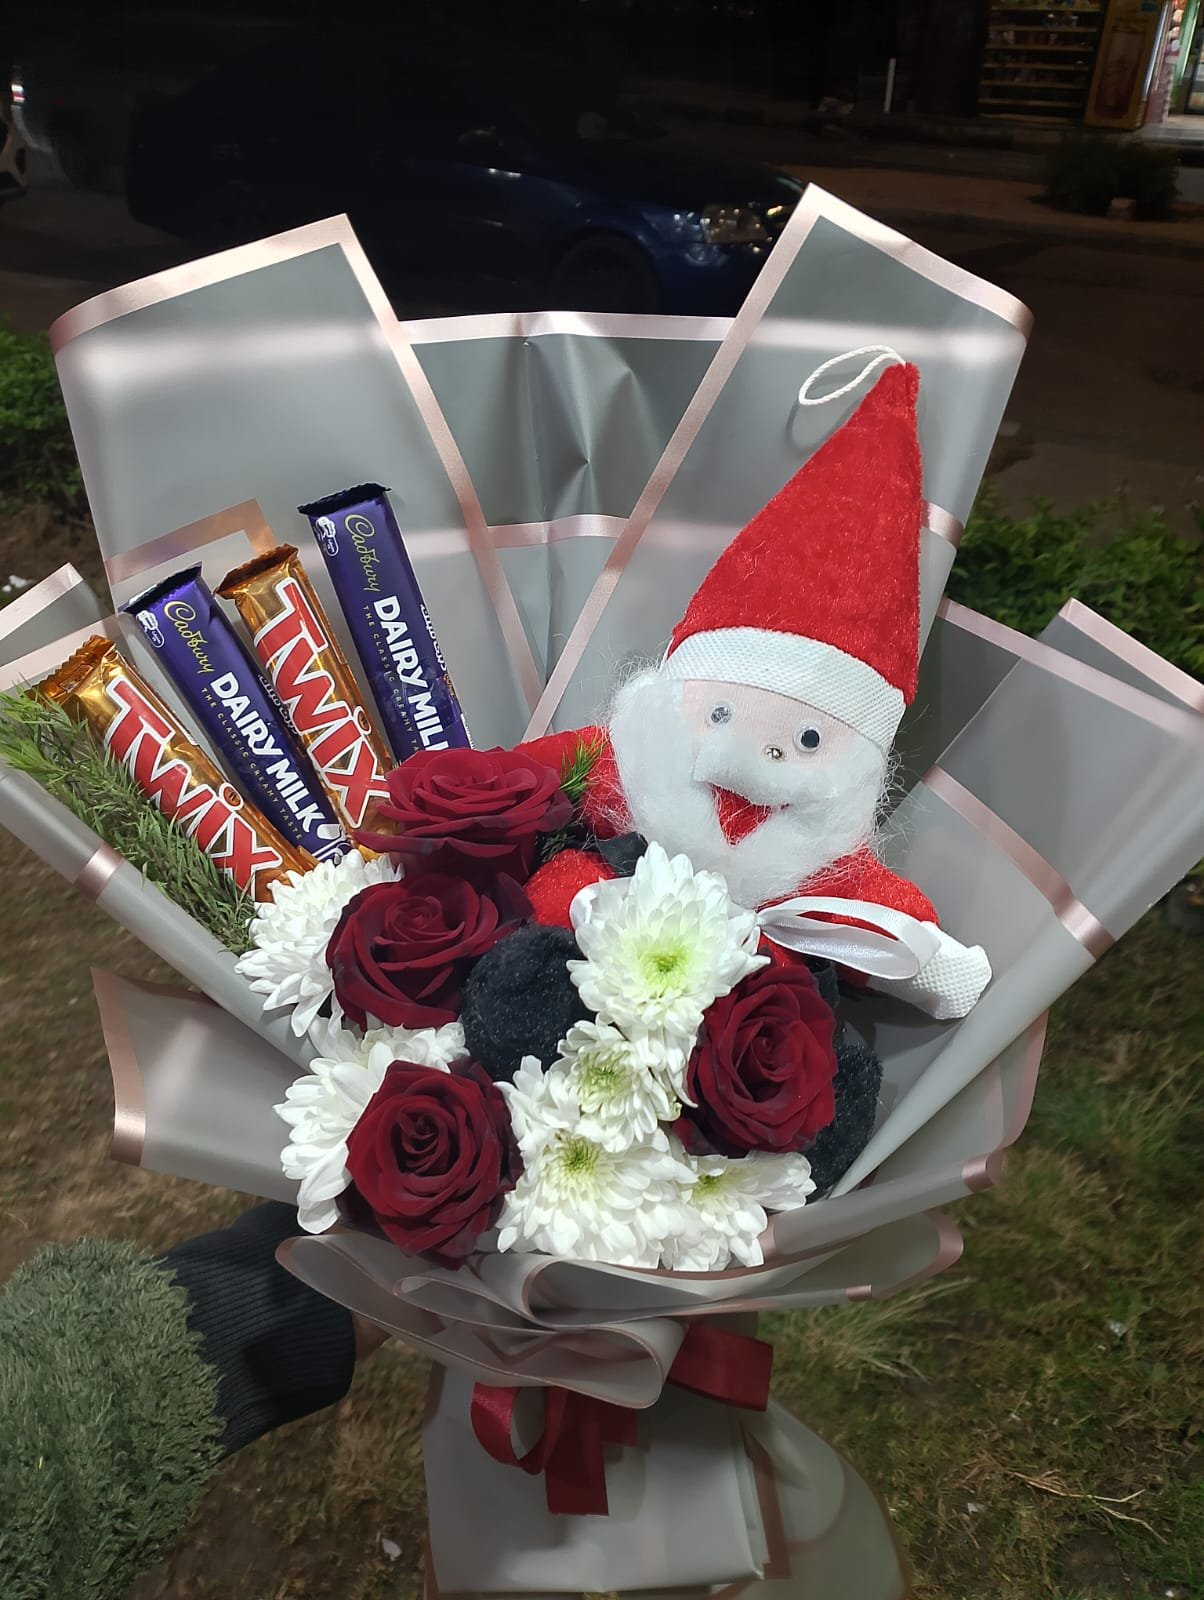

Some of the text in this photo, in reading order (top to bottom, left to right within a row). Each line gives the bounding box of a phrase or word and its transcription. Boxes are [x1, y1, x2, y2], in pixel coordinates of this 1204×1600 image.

[344, 514, 381, 592] Cadbury
[163, 601, 215, 674] Cadbury
[362, 604, 376, 627] THE
[373, 633, 395, 682] CLASSIC
[373, 595, 429, 688] DAIRY
[201, 687, 217, 708] THE
[217, 712, 249, 758] CLASSIC
[280, 808, 303, 840] TASTE
[210, 671, 326, 833] DAIRY MILK
[253, 576, 390, 829] TWIX
[104, 676, 283, 900] TWIX
